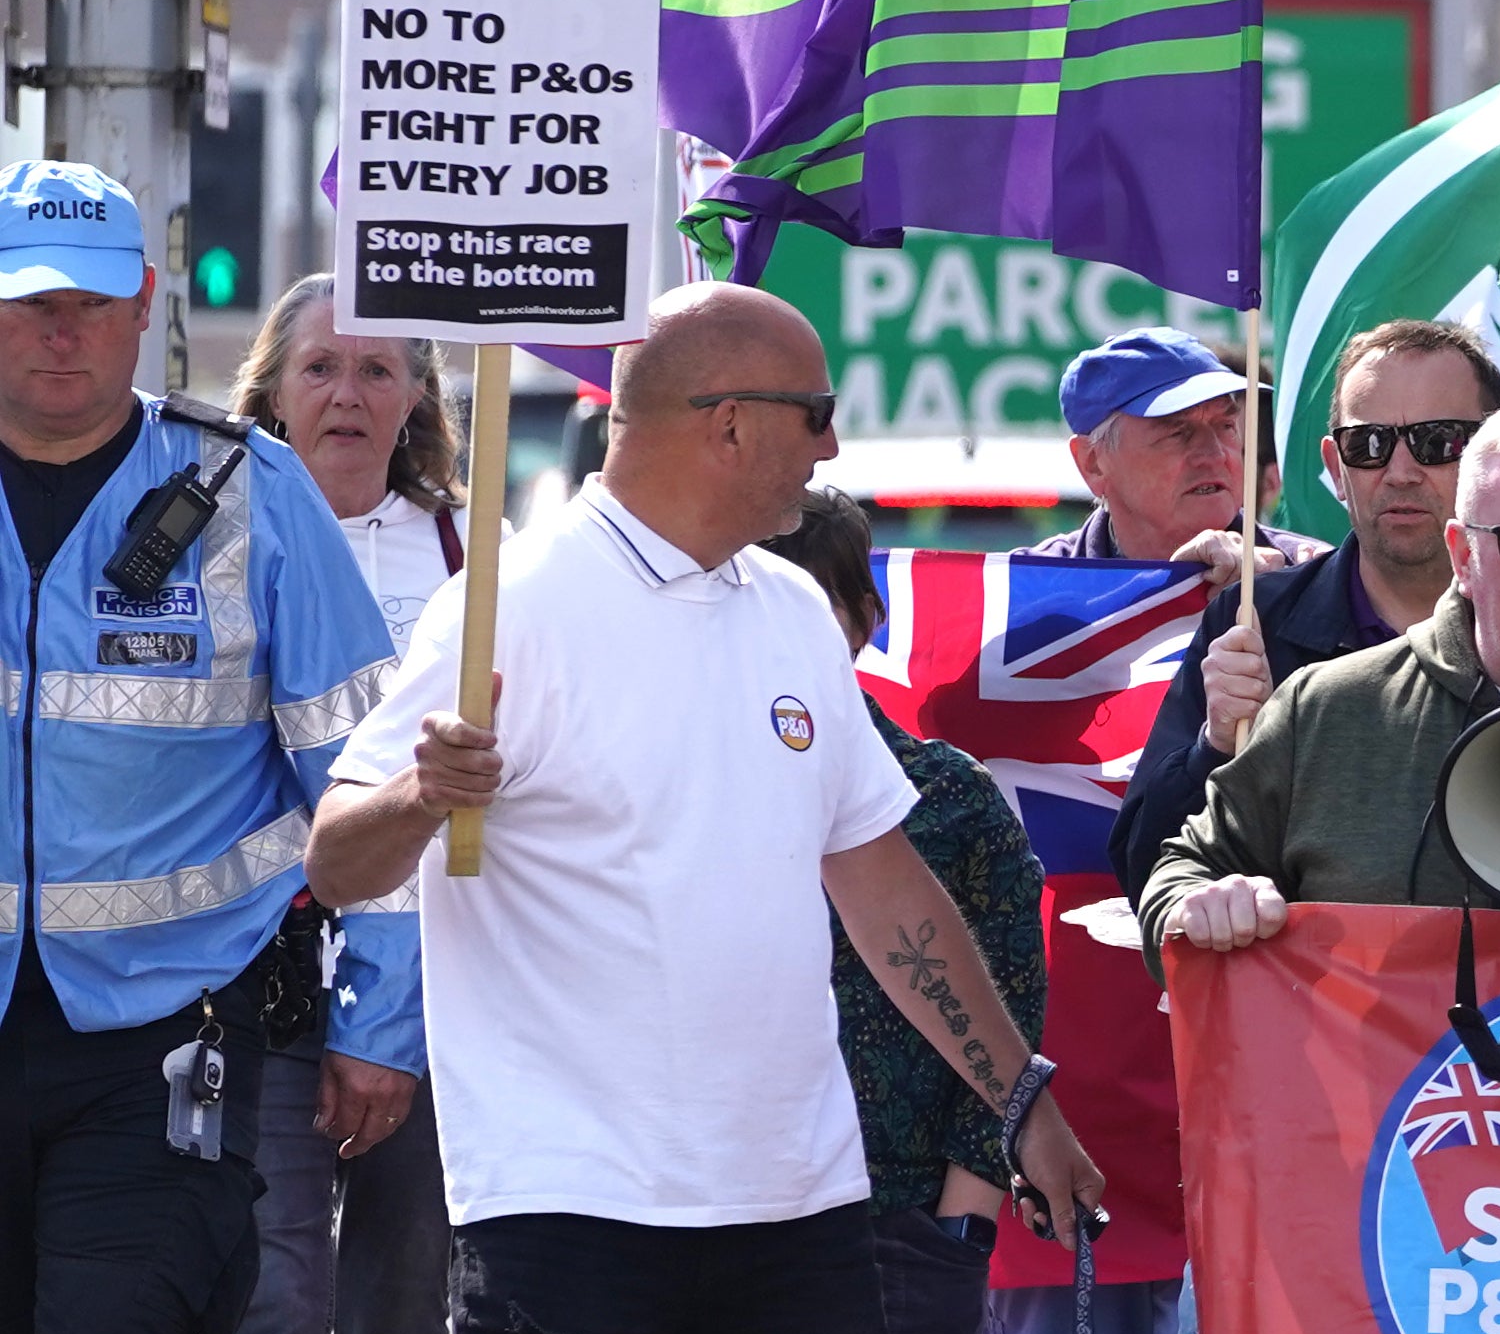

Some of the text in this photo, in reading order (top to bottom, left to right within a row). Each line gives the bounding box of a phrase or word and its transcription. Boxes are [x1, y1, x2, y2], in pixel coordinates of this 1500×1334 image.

[362, 8, 505, 44] NO TO
[361, 58, 634, 94] MORE P&Os
[360, 109, 601, 145] FIGHT FOR
[359, 160, 609, 196] EVERY JOB
[28, 199, 107, 223] POLICE
[366, 227, 592, 257] Stop this race
[366, 259, 596, 288] to the bottom
[478, 304, 619, 317] www.socialistworker.co.uk
[102, 602, 193, 617] LIAISON
[128, 648, 165, 658] THANET
[776, 716, 811, 740] P&O
